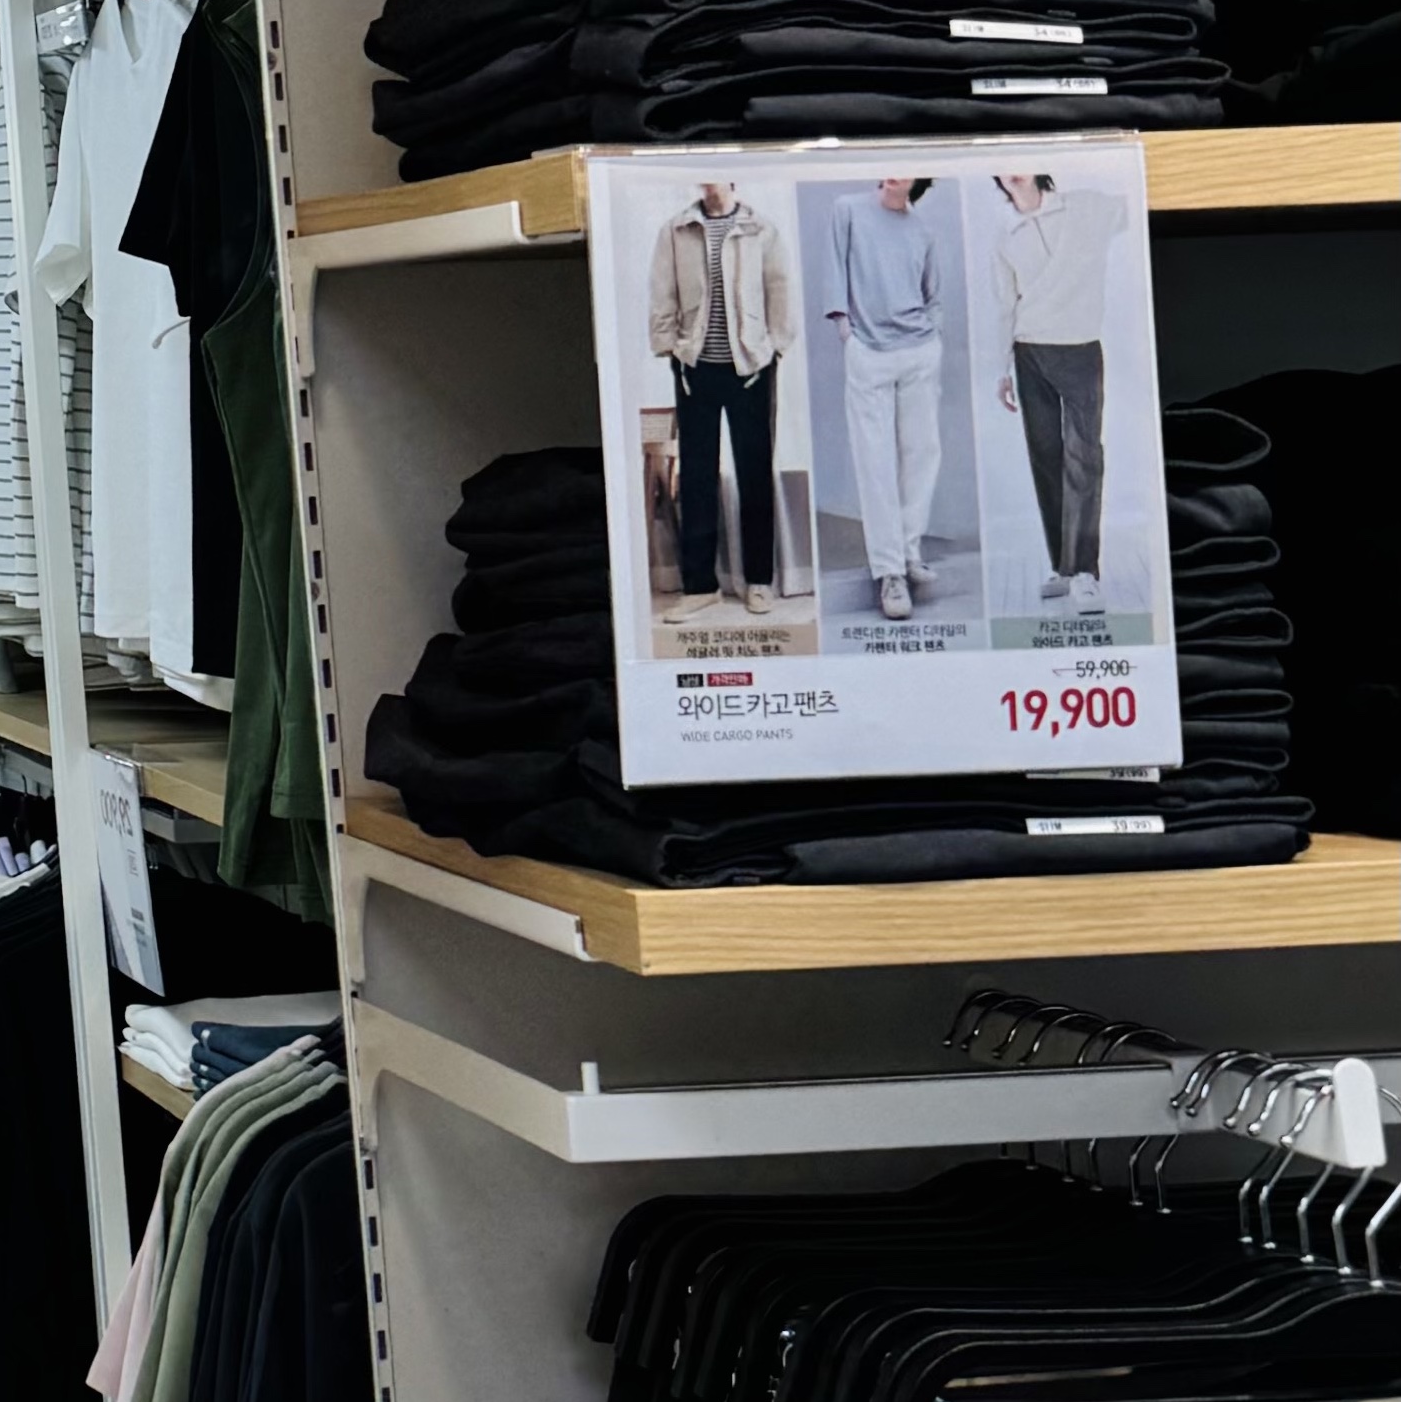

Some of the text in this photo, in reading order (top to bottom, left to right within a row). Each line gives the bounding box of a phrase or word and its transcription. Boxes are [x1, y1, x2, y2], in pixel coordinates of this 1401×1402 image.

[1075, 659, 1130, 679] 59,900
[1000, 686, 1137, 739] 19,900
[681, 728, 794, 742] WIDE CARGO PANTS
